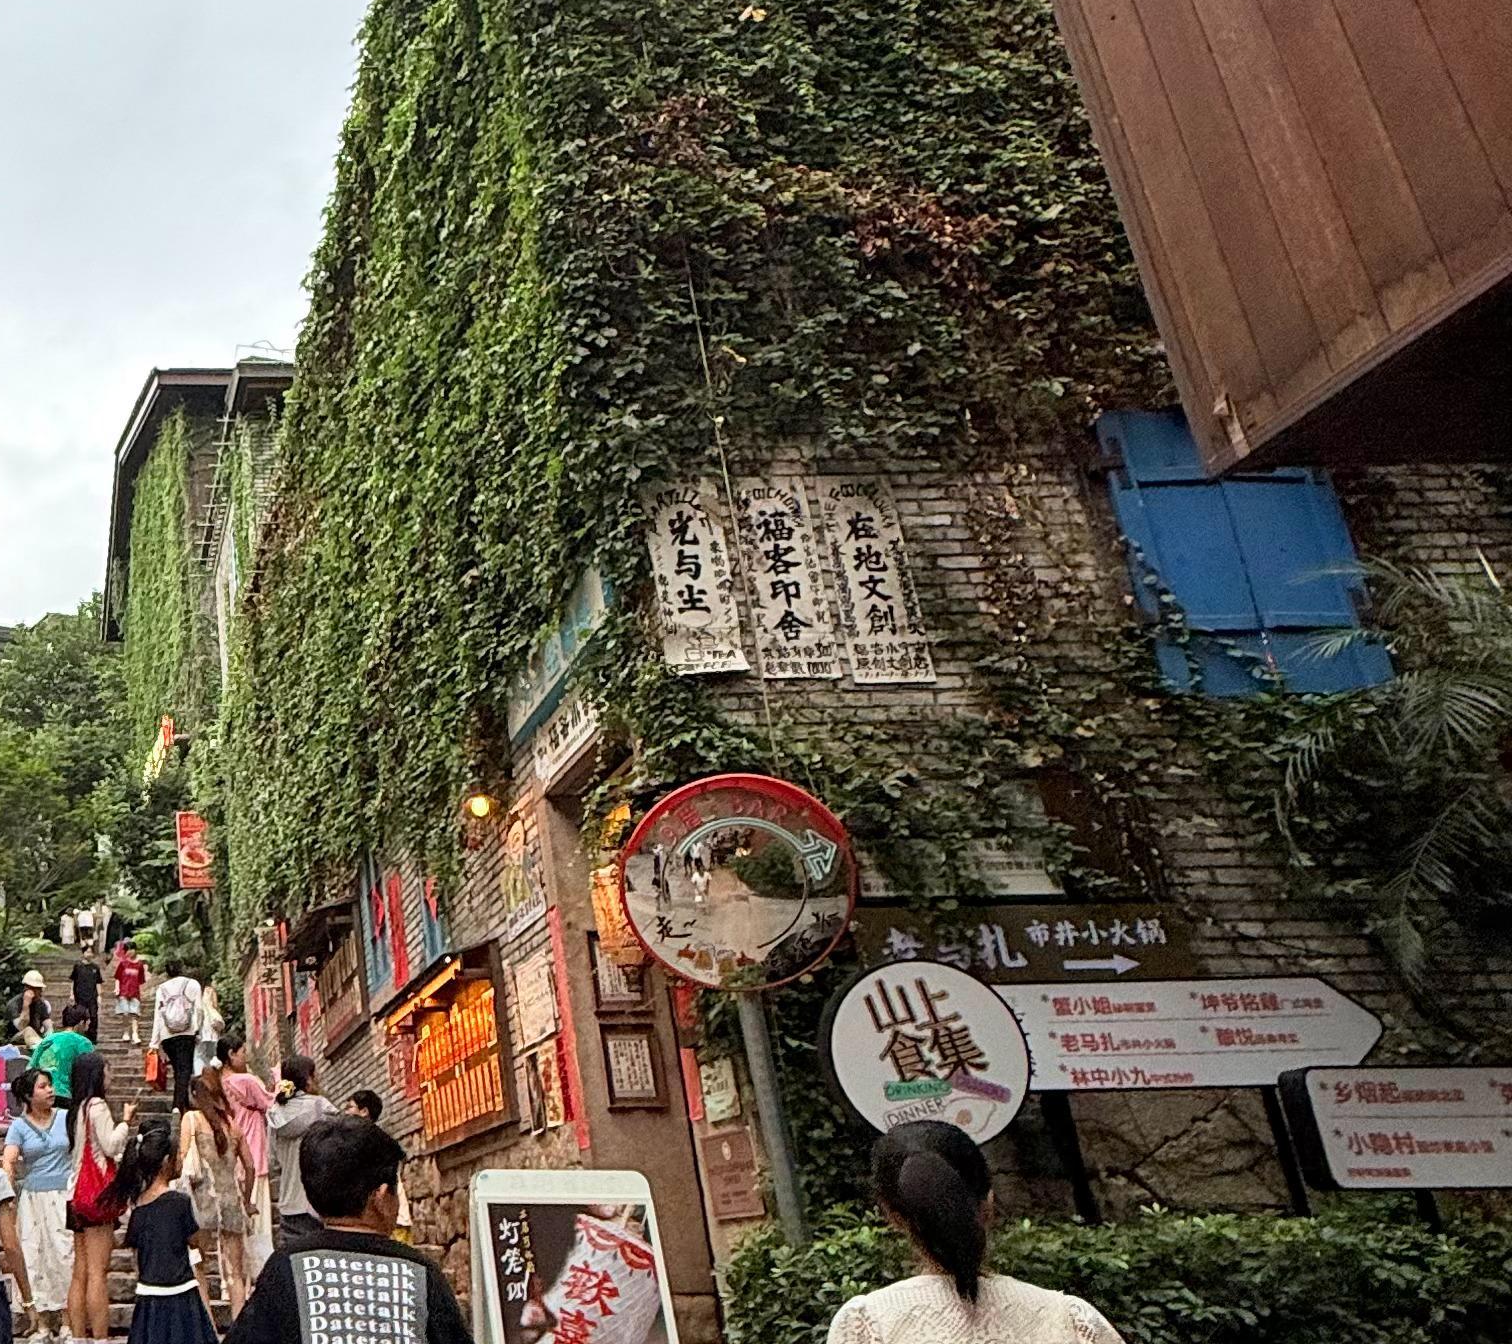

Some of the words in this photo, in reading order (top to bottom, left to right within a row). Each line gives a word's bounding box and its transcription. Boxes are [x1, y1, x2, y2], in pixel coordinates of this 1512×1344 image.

[667, 509, 712, 616] 光与尘
[1024, 917, 1168, 947] 市井小火锅
[862, 977, 963, 1034] 山上
[1060, 1031, 1121, 1053] 老马扎
[878, 1024, 991, 1083] 食集
[1070, 1065, 1151, 1086] 林中小九
[887, 1097, 946, 1127] DINNER
[302, 1256, 415, 1278] Datetalk
[304, 1270, 416, 1291] Datetalk
[306, 1284, 416, 1306] Datetalk
[308, 1300, 417, 1322] Datetalk
[309, 1316, 417, 1338] Datetalk
